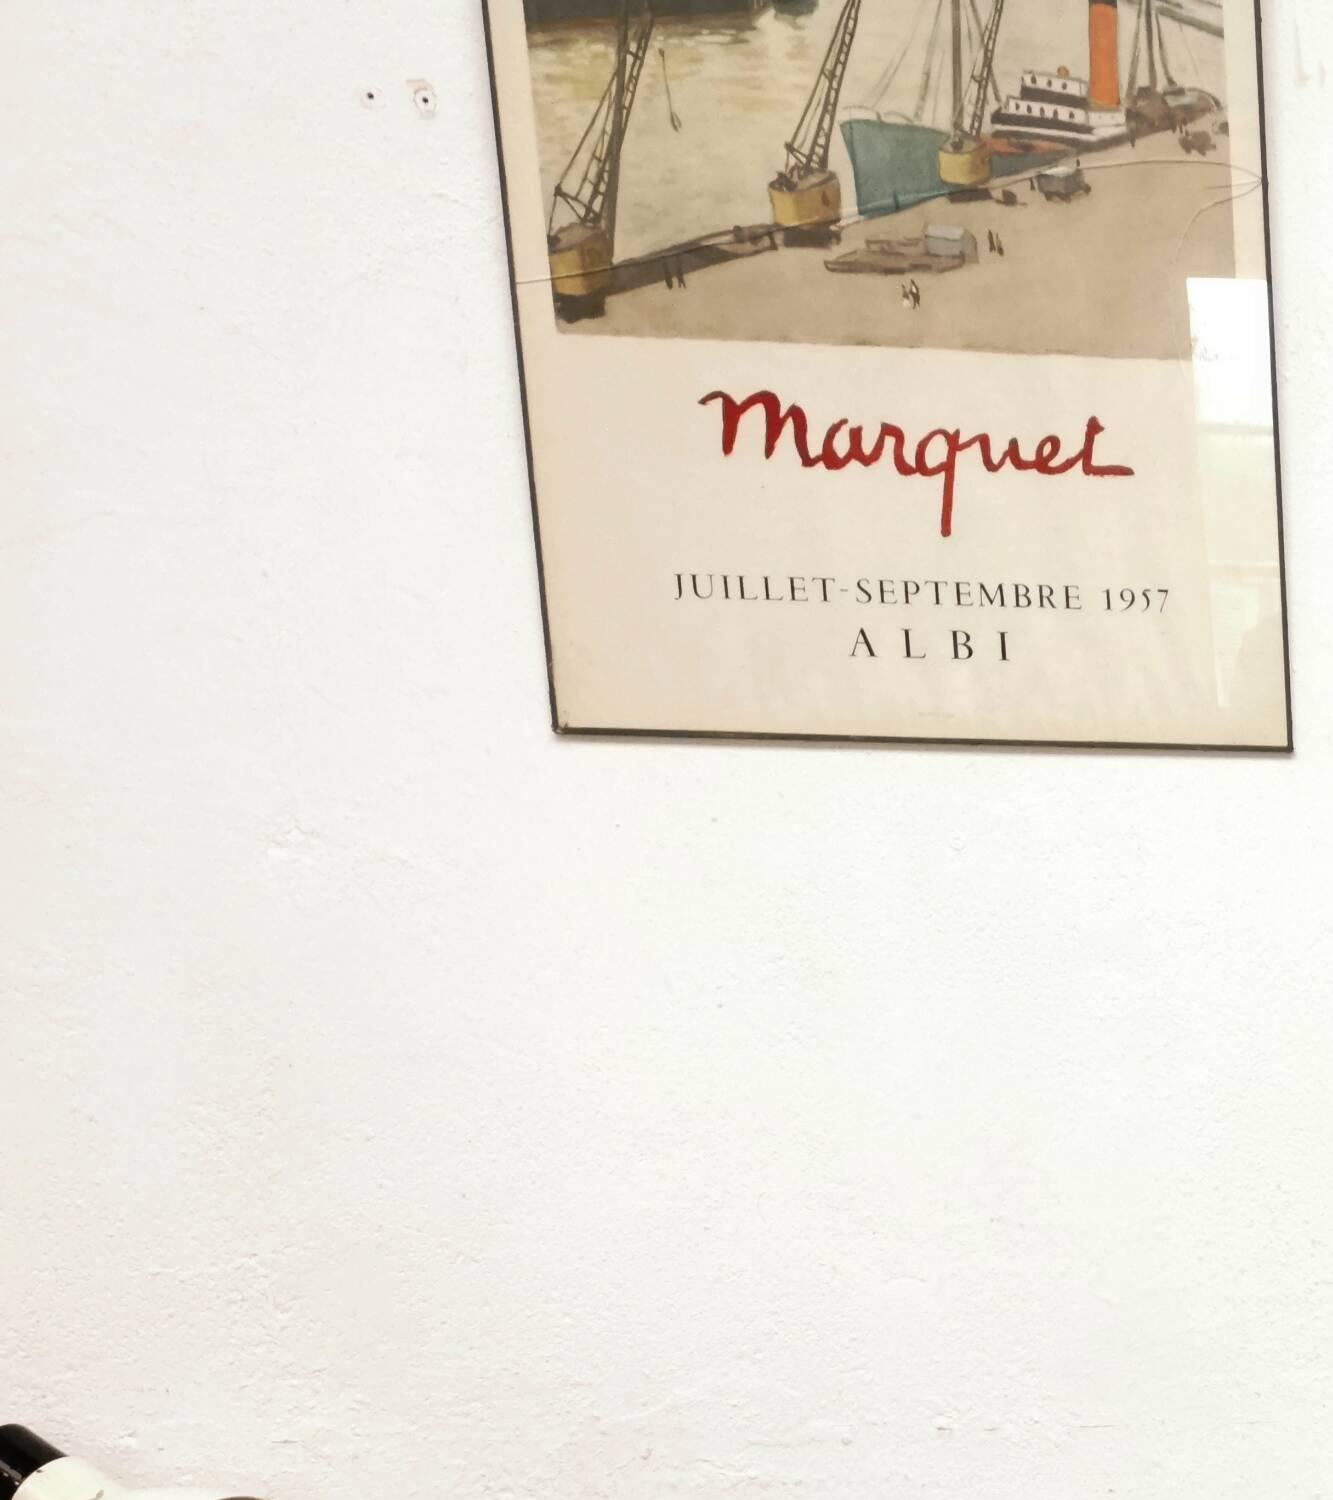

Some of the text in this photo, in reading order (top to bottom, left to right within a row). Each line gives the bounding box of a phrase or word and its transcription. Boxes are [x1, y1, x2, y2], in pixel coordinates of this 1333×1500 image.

[698, 390, 1135, 538] Marquet
[674, 573, 1169, 613] JUILLET-SEPTEMBRE 1957
[848, 627, 1011, 662] ALBI
